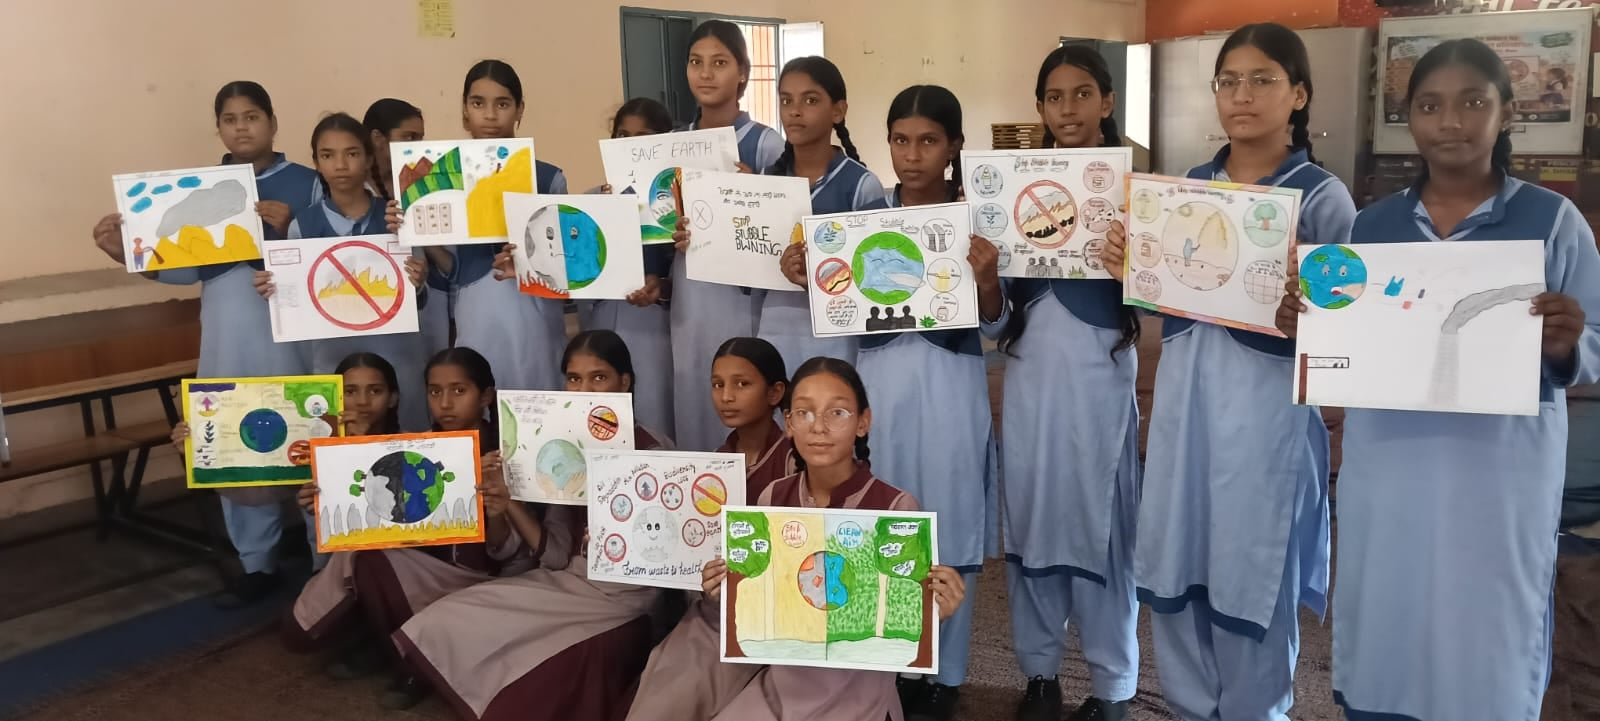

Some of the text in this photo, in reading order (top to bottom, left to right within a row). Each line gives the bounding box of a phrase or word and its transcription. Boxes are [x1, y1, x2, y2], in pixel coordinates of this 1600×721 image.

[631, 141, 713, 162] SAVE EARTH
[732, 216, 751, 228] STOP
[846, 215, 869, 226] STOP
[735, 226, 771, 242] STUBBLE
